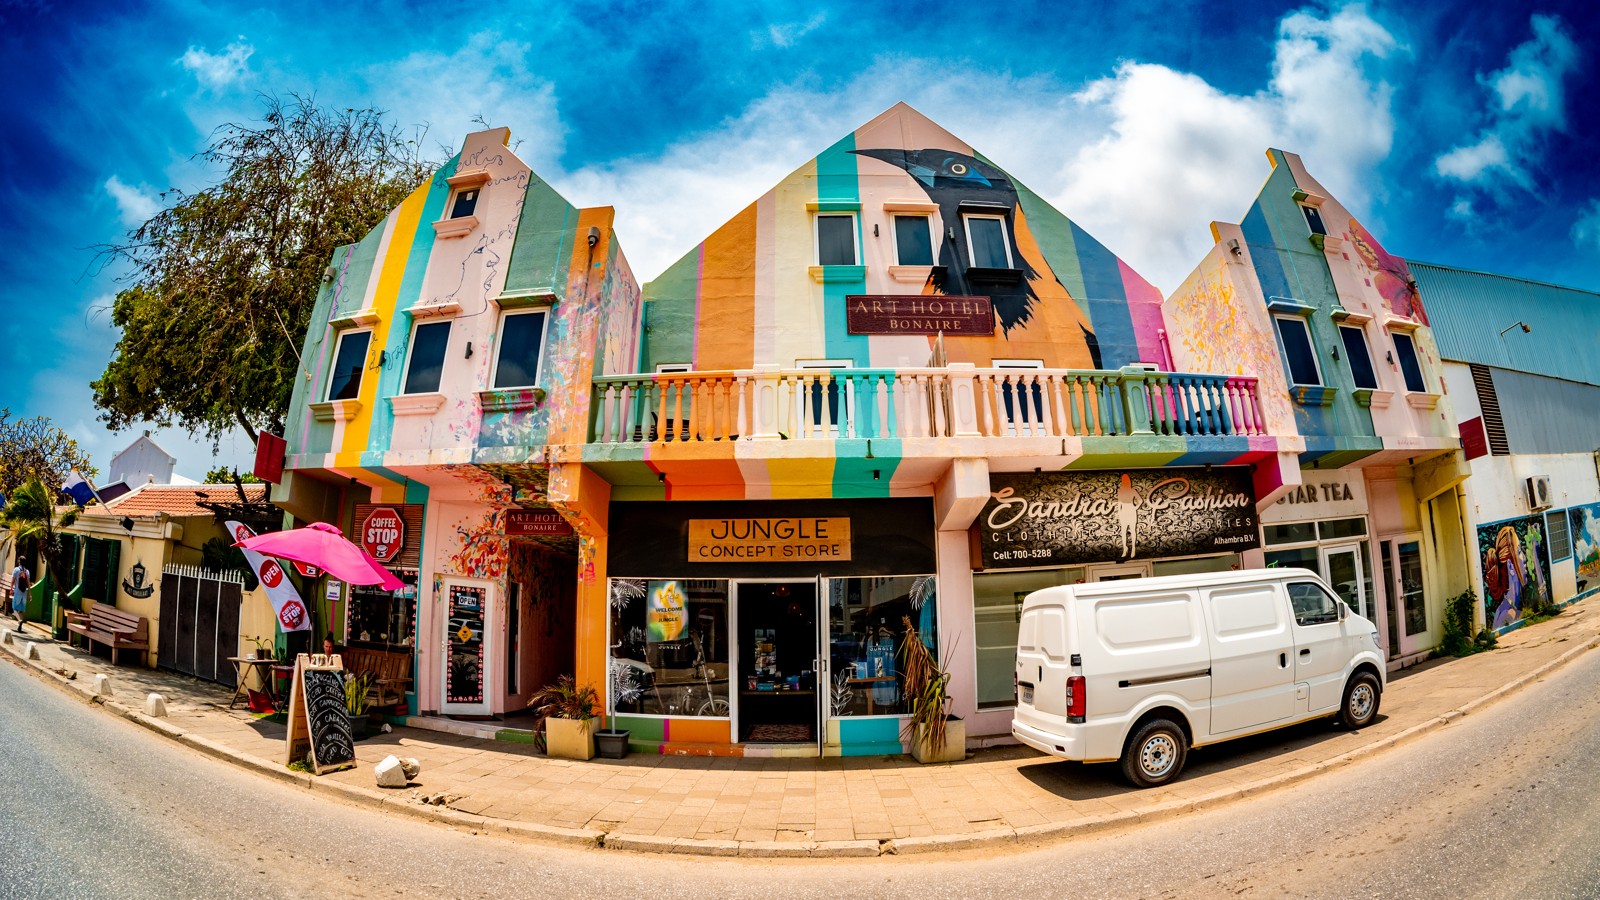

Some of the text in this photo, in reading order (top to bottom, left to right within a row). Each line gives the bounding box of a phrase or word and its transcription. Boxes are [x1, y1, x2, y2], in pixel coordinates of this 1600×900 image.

[855, 300, 985, 315] ART HOTEL
[890, 320, 962, 330] BONAIRE
[1320, 483, 1354, 502] TEA
[987, 477, 1249, 529] Sandra Fashion
[371, 518, 396, 528] COFFEE
[510, 513, 569, 522] ART HOTE
[367, 529, 398, 544] STOP
[711, 519, 828, 540] JUNGLE
[1213, 534, 1256, 545] Alhambra B.V.
[699, 544, 840, 558] CONCEPT STORE
[993, 549, 1052, 560] Cell: 700-5288
[263, 564, 280, 584] OPEN
[459, 596, 477, 606] OPEN
[283, 606, 301, 624] STOP
